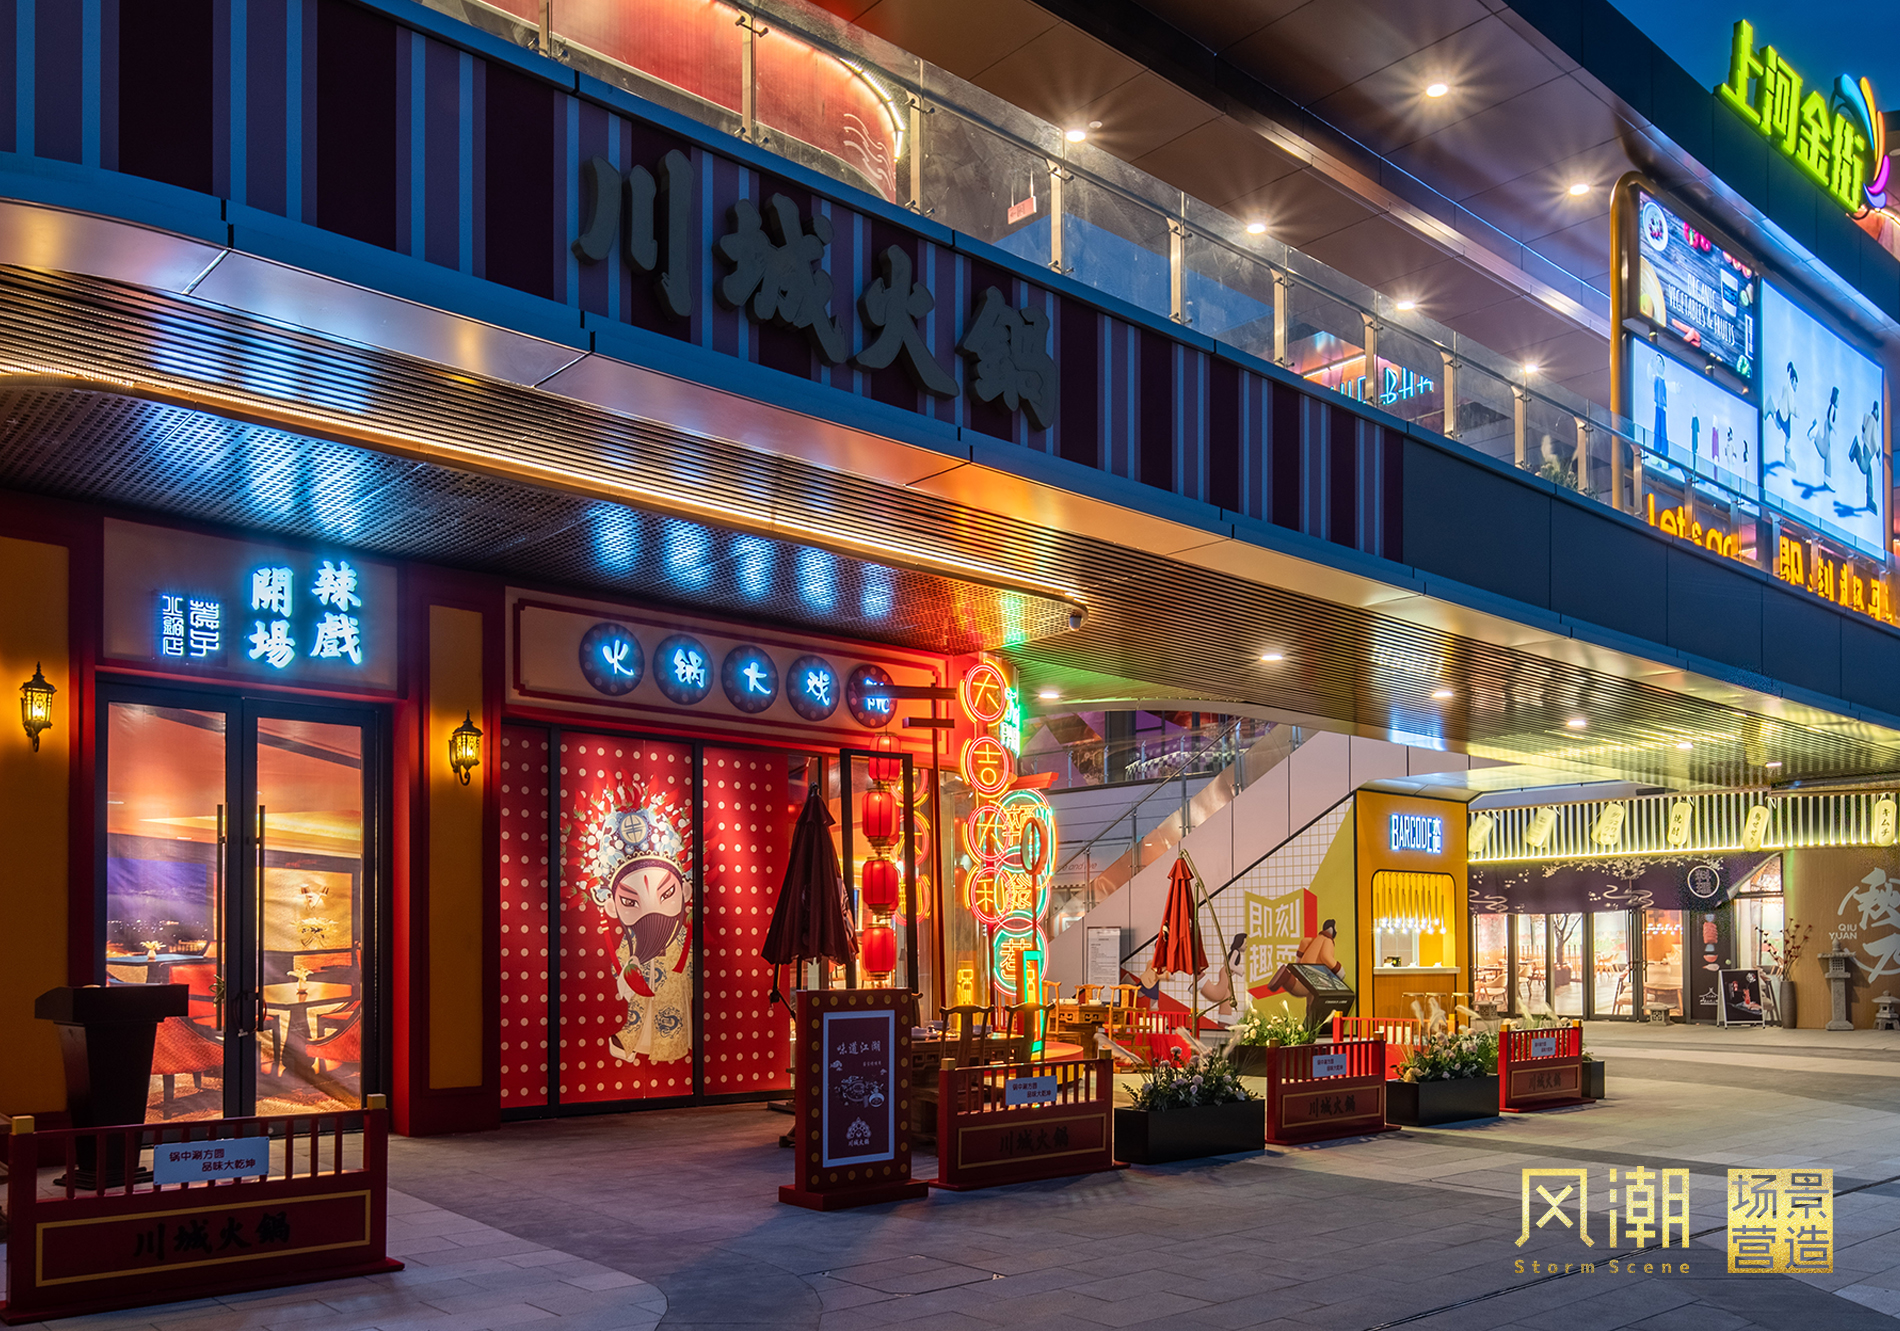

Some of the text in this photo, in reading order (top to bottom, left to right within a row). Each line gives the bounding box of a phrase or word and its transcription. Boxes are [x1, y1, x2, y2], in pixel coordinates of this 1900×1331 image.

[1714, 19, 1865, 213] 上河金街
[571, 149, 1059, 431] 川城火鍋
[1391, 814, 1432, 852] BARCODE
[1881, 808, 1890, 837] キムチ
[1249, 898, 1300, 939] 即刻
[1838, 923, 1857, 932] QIU
[1829, 932, 1857, 940] YUAN
[169, 1148, 225, 1163] 锅中涮方圆
[201, 1158, 256, 1172] 品味大乾坤
